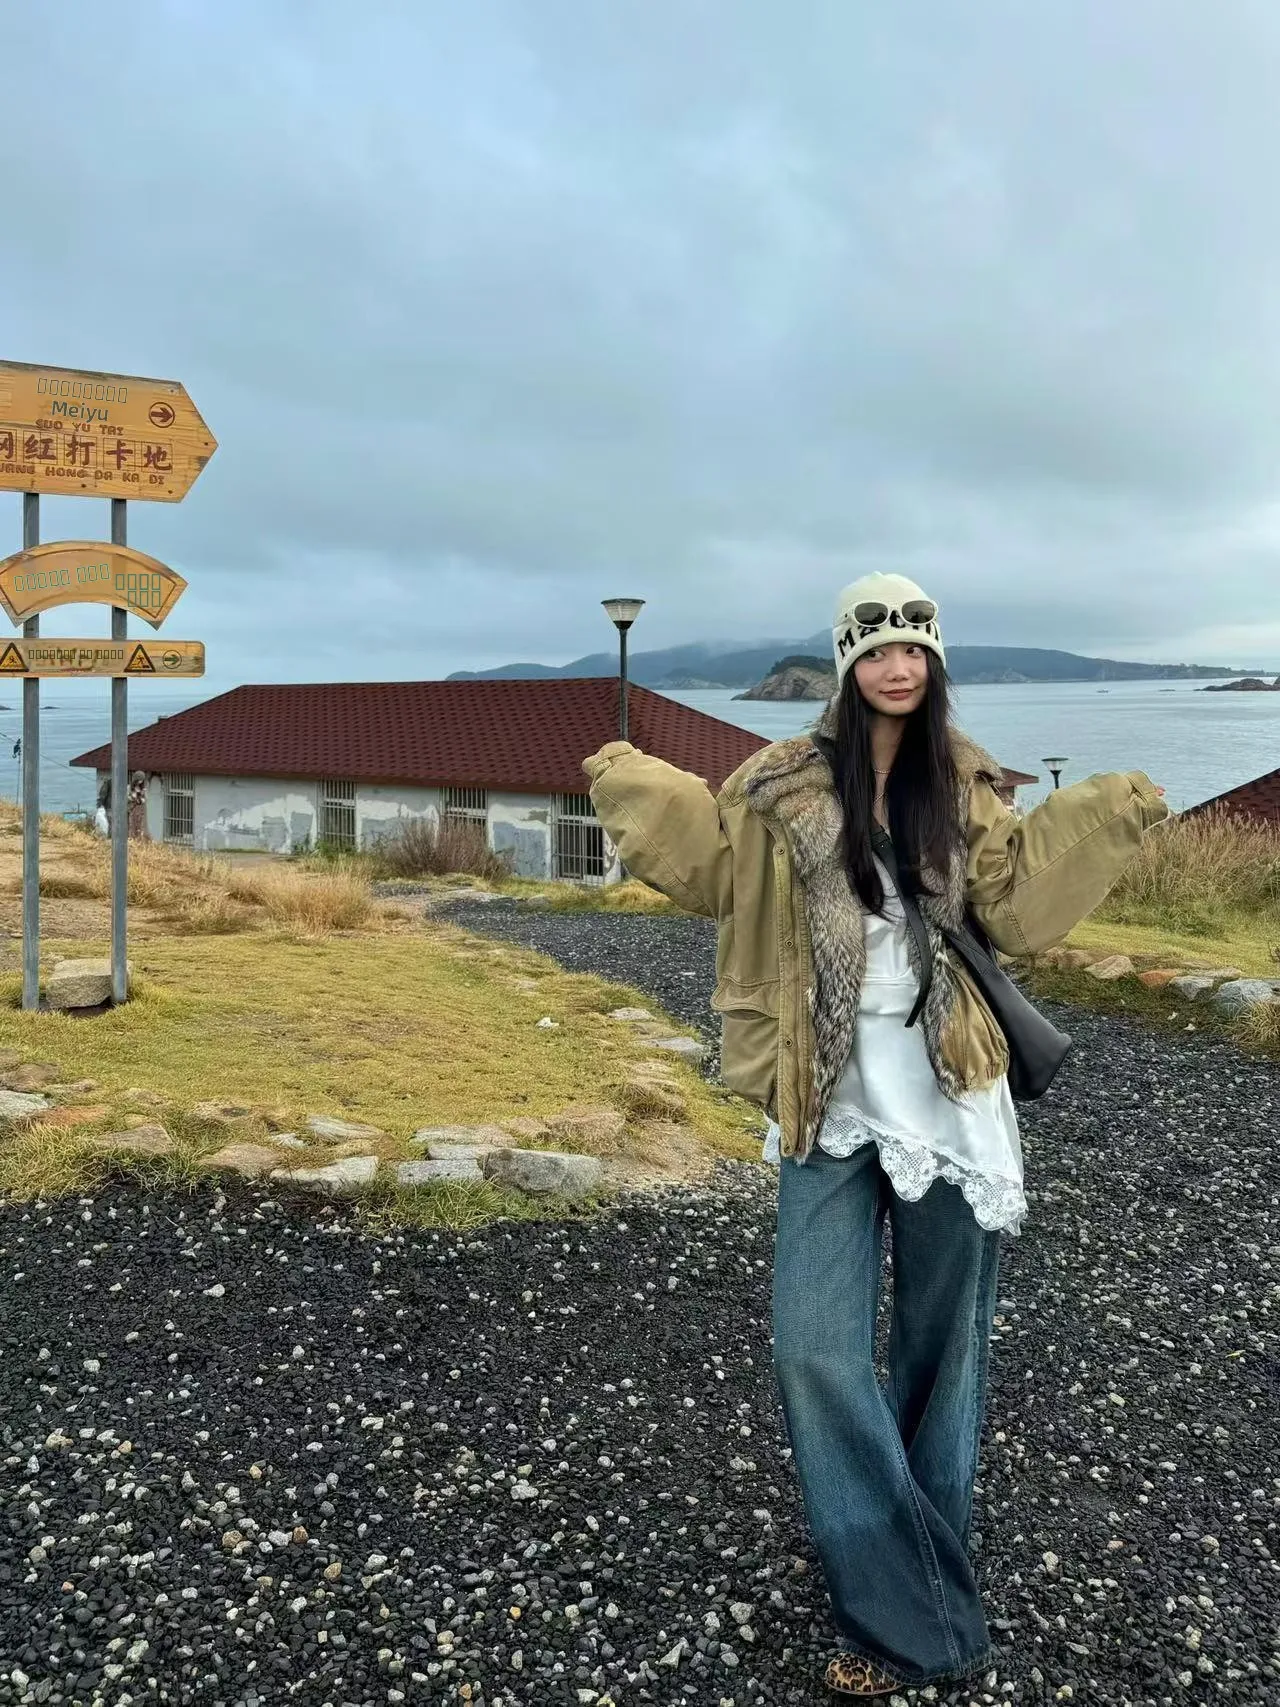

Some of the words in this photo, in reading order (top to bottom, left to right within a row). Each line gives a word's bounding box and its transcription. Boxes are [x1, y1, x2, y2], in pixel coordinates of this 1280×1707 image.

[35, 418, 63, 430] SUO
[72, 422, 91, 433] YU
[45, 466, 88, 478] HONG
[94, 470, 113, 481] DA
[122, 472, 140, 483] KA
